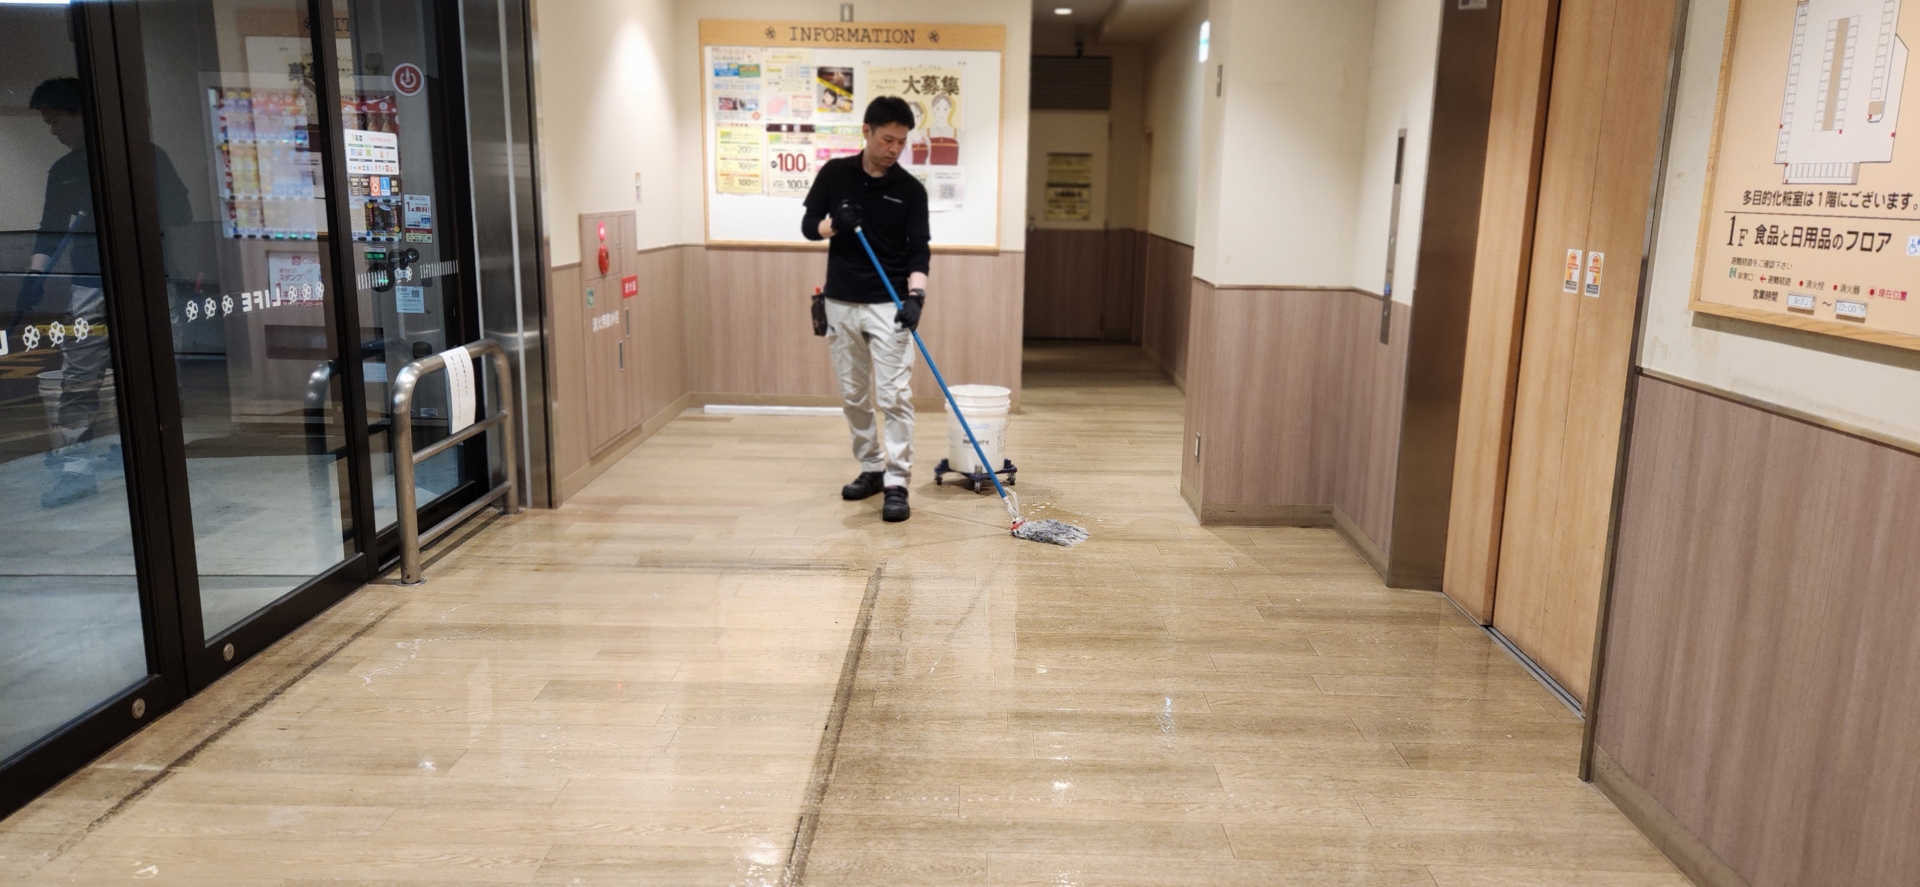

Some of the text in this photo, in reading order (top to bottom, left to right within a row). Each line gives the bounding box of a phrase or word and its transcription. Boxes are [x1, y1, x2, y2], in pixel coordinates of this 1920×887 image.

[789, 27, 915, 44] INFORMATION
[902, 75, 960, 96] 大募集
[777, 153, 807, 172] 100
[738, 178, 752, 186] 100
[1754, 224, 1893, 254] 食品と日用品のフロア
[1752, 289, 1779, 303] 営業時間
[1767, 275, 1792, 287] 避難経路
[1805, 279, 1825, 291] 消火栓
[1839, 283, 1860, 295] 消火器
[1878, 288, 1908, 302] 現在位置
